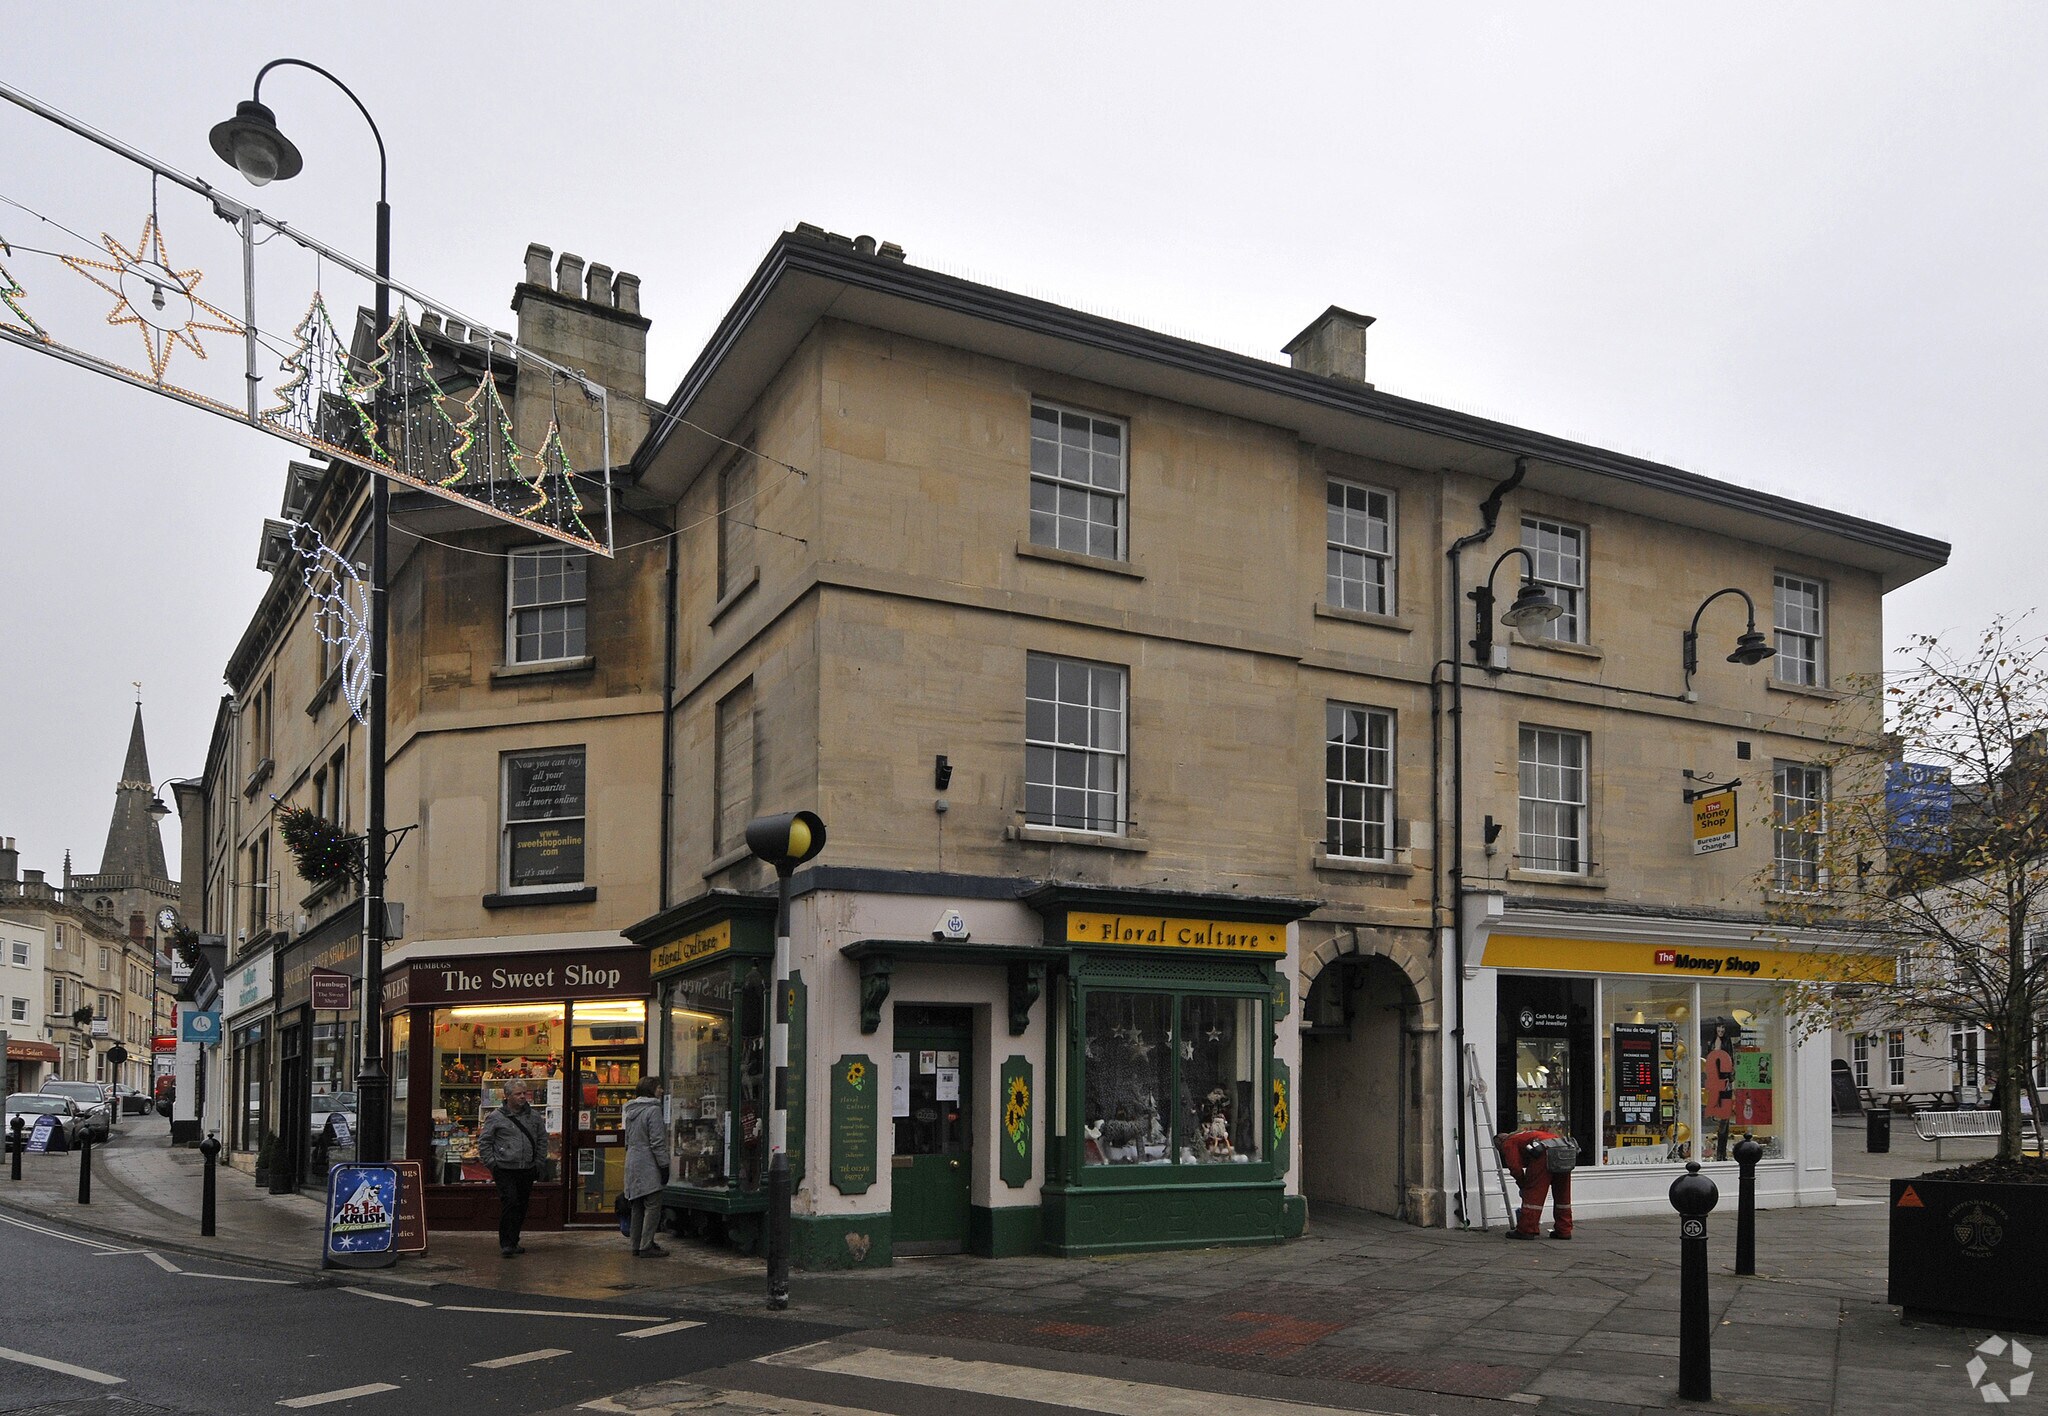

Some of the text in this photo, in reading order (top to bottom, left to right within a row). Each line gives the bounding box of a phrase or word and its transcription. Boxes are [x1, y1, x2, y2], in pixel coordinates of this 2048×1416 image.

[514, 757, 581, 771] Now you can buy
[533, 771, 564, 782] all your
[527, 784, 566, 796] favourites
[515, 795, 578, 807] and more online
[1707, 803, 1720, 811] The
[543, 810, 552, 818] at
[1696, 808, 1730, 821] Money
[1701, 817, 1726, 828] Shop
[539, 830, 560, 838] www.
[517, 836, 582, 849] sweetshoponline
[1697, 836, 1721, 845] Bureau
[1701, 841, 1727, 851] Change
[540, 848, 558, 856] .com
[1102, 918, 1258, 947] Floral Culture
[329, 941, 346, 967] SHOP
[346, 934, 359, 957] LTD
[657, 934, 718, 967] Floral Culture
[412, 962, 451, 971] HUMBUGS
[1658, 953, 1760, 975] The Money Shop
[441, 965, 621, 991] The Sweet Shop
[382, 976, 408, 1002] SWEETS
[6, 1046, 43, 1056] Salad Select
[344, 1200, 383, 1215] Polar
[340, 1213, 386, 1224] KRUSH
